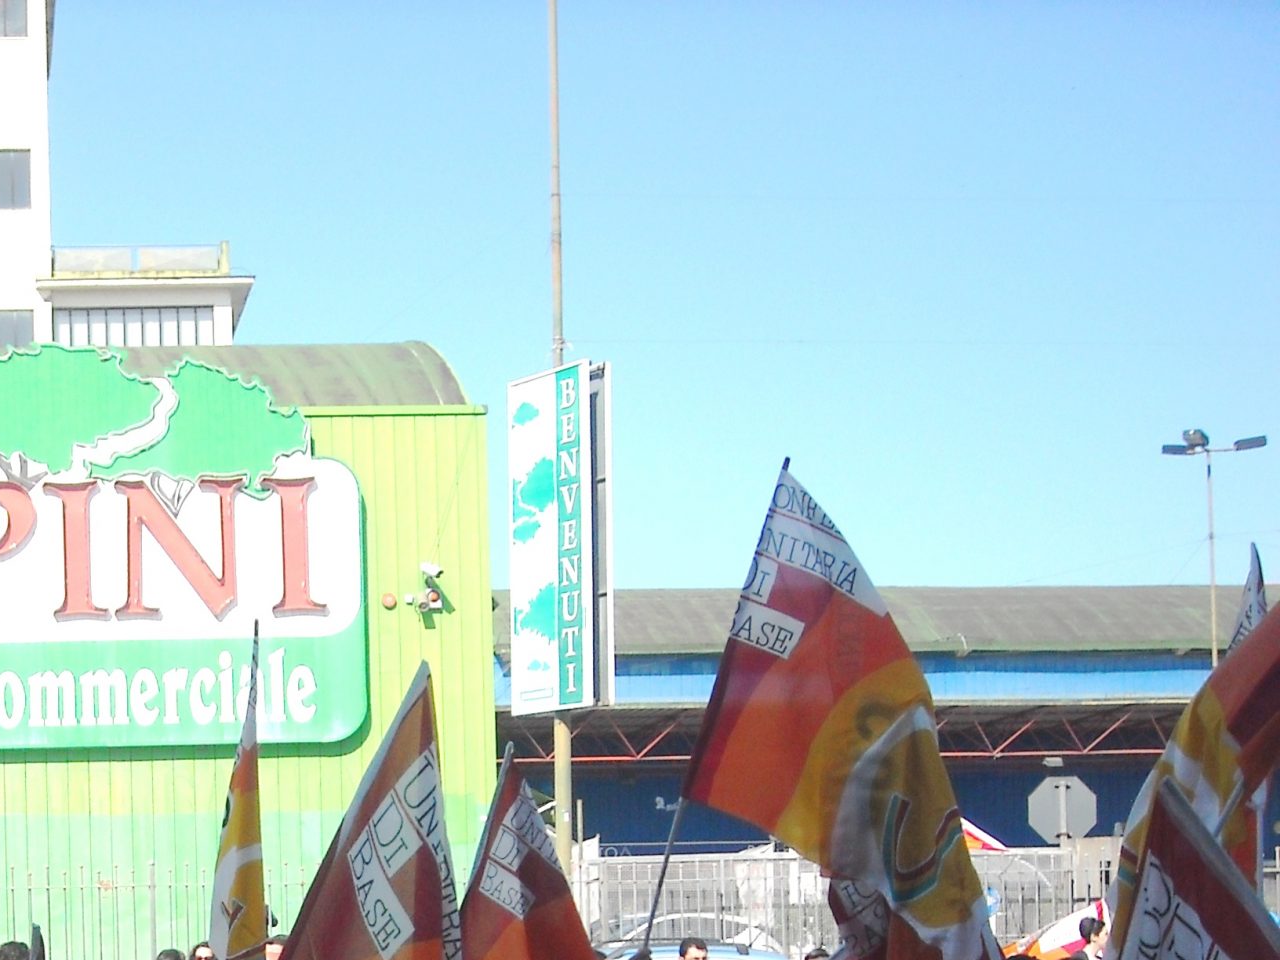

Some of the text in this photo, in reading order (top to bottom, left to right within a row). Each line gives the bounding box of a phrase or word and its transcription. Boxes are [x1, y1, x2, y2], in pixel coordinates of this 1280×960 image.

[558, 376, 581, 694] BENVENUTI
[372, 801, 409, 868] DI
[351, 836, 402, 951] BASE
[481, 868, 528, 913] BASE
